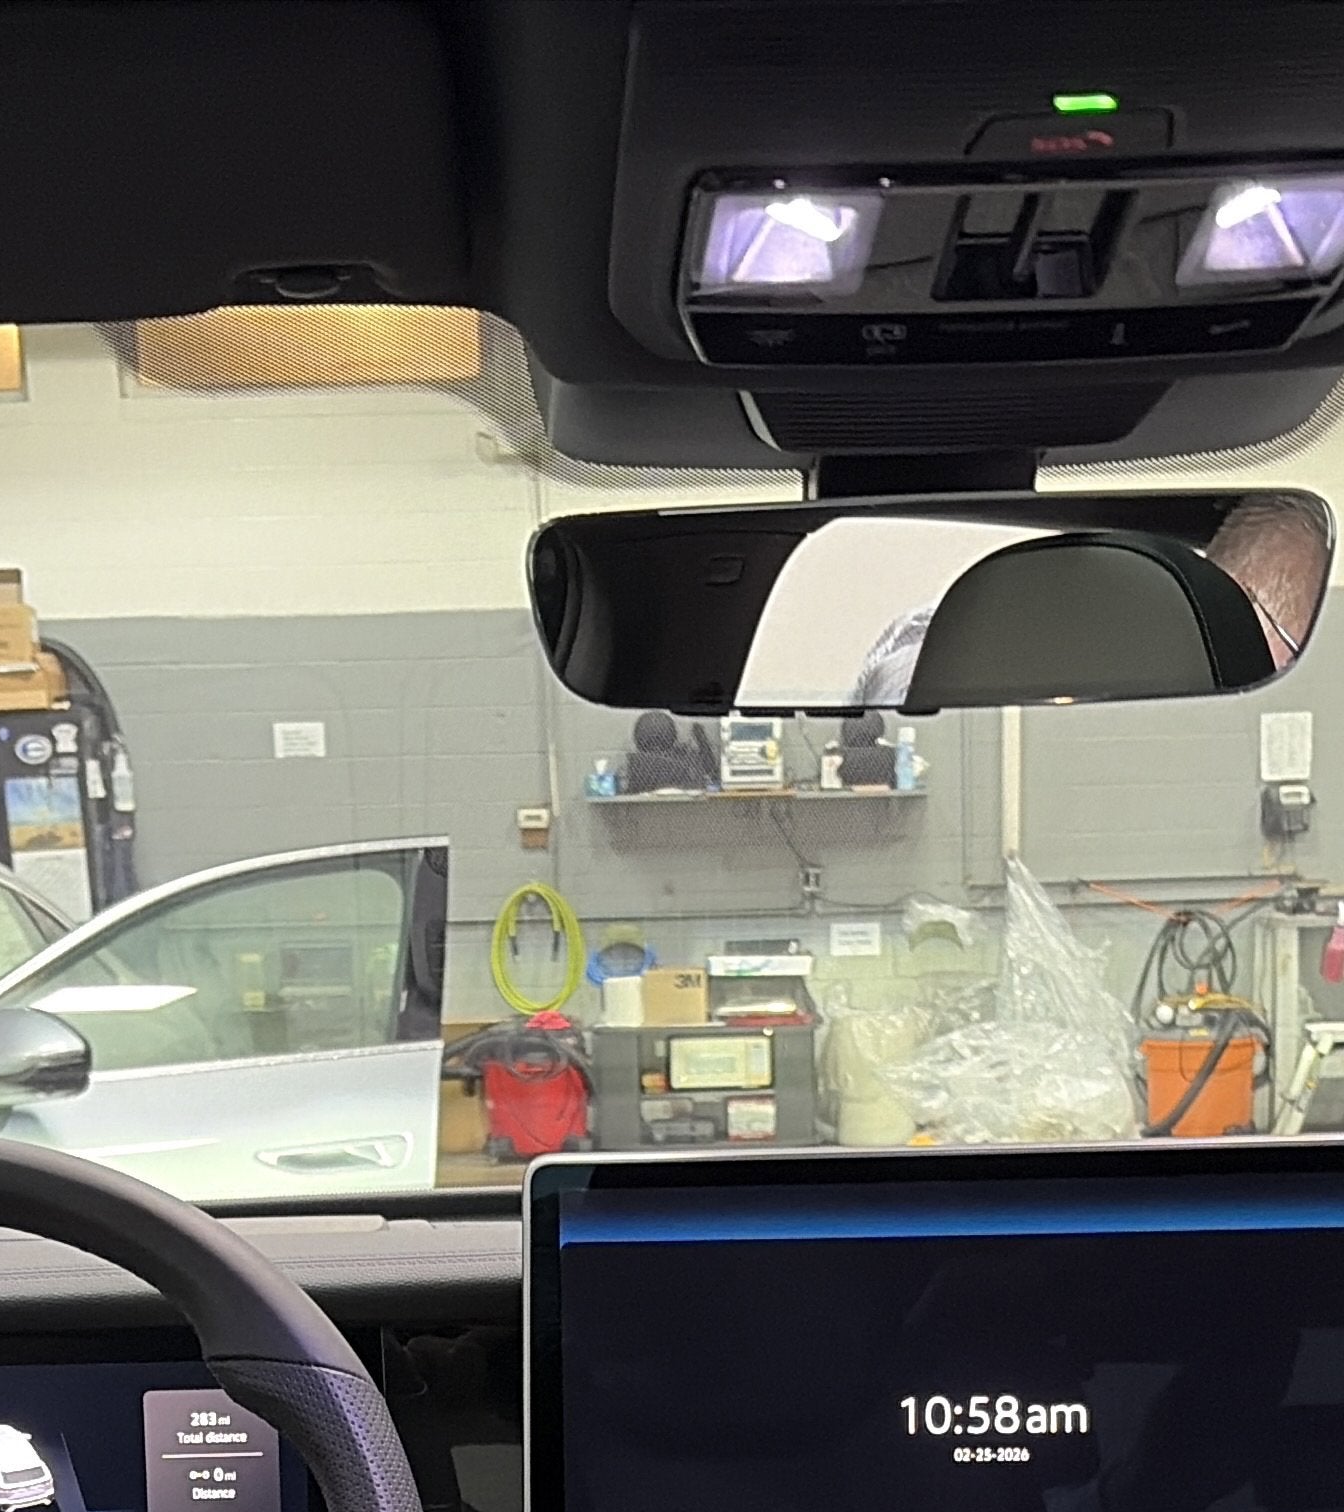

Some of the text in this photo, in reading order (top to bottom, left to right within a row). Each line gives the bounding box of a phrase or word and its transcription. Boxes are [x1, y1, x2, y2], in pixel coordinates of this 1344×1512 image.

[190, 1411, 216, 1426] 283
[900, 1395, 1088, 1435] 10:58am
[176, 1431, 248, 1444] Total distance
[953, 1447, 1030, 1462] 02-25-2026
[192, 1487, 236, 1500] Distance
